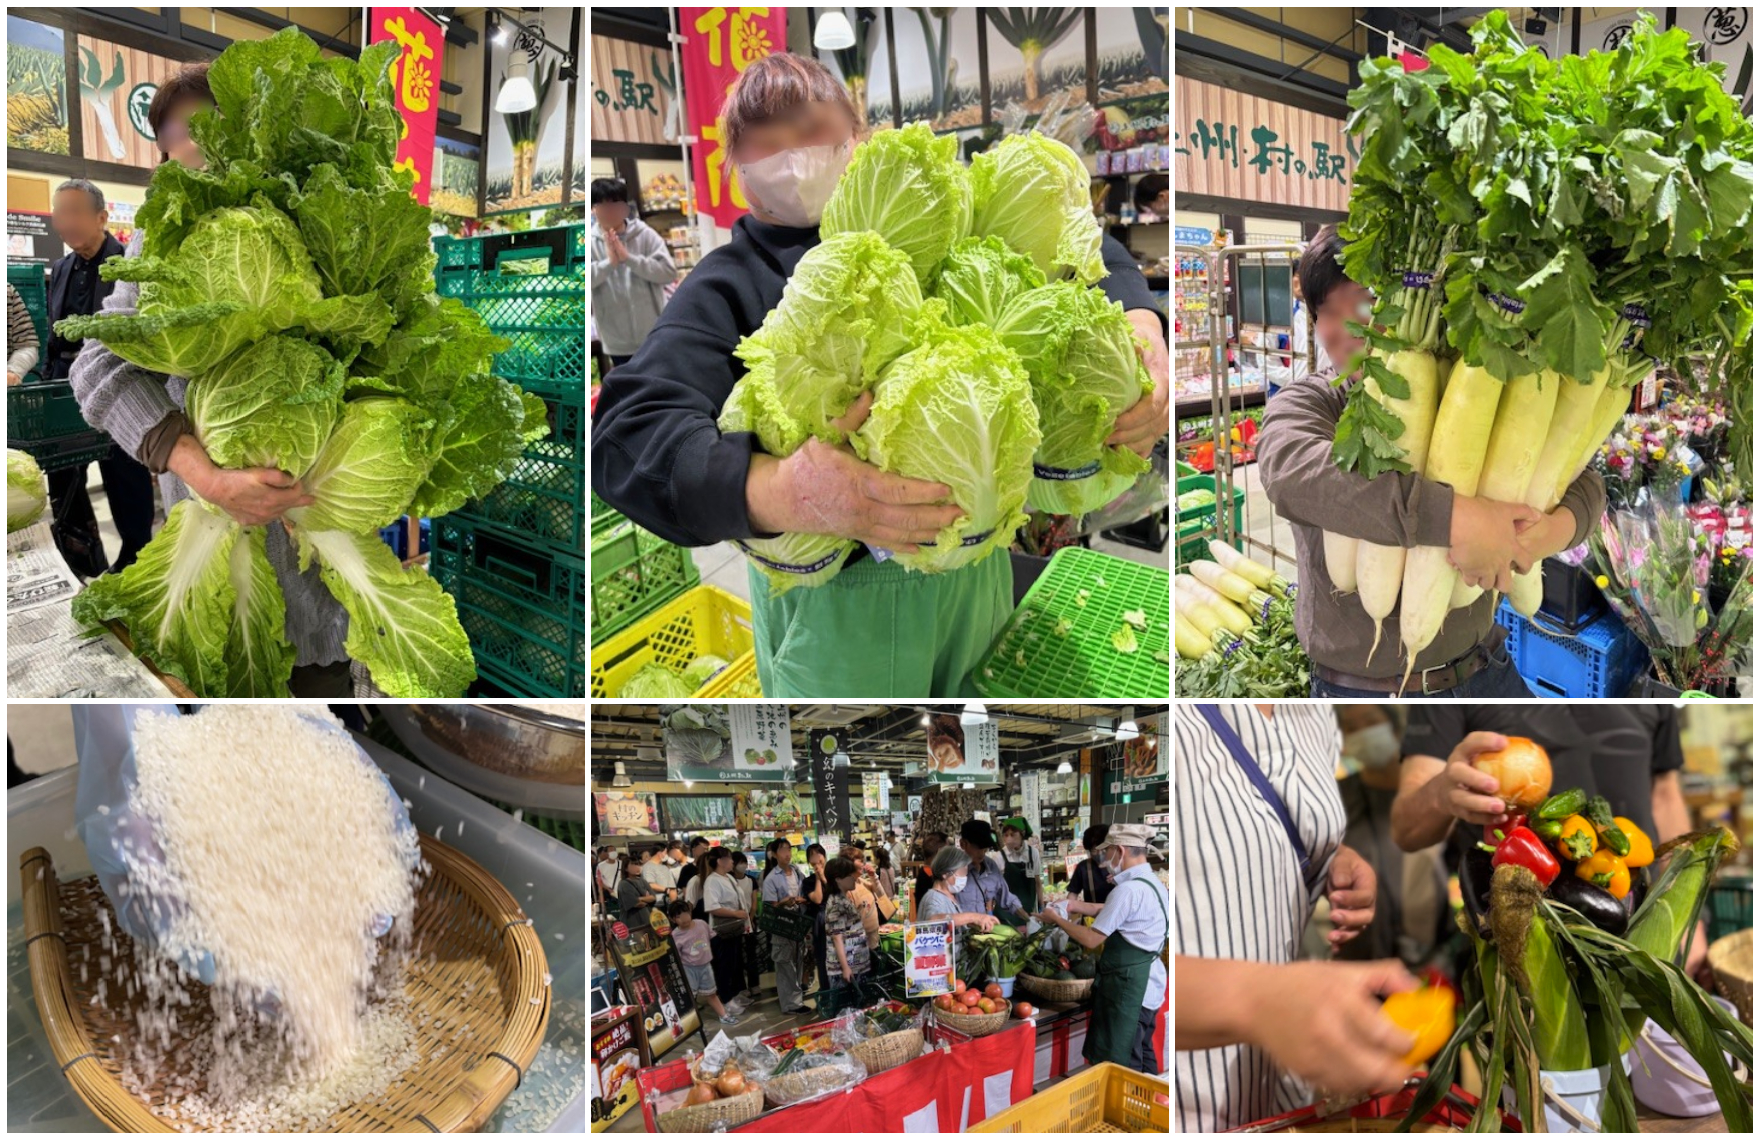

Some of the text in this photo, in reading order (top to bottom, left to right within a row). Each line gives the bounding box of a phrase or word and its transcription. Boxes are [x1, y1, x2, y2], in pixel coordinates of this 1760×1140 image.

[822, 756, 838, 829] 幻のキャベツ
[612, 811, 643, 821] キッチン
[914, 935, 945, 945] バケツに
